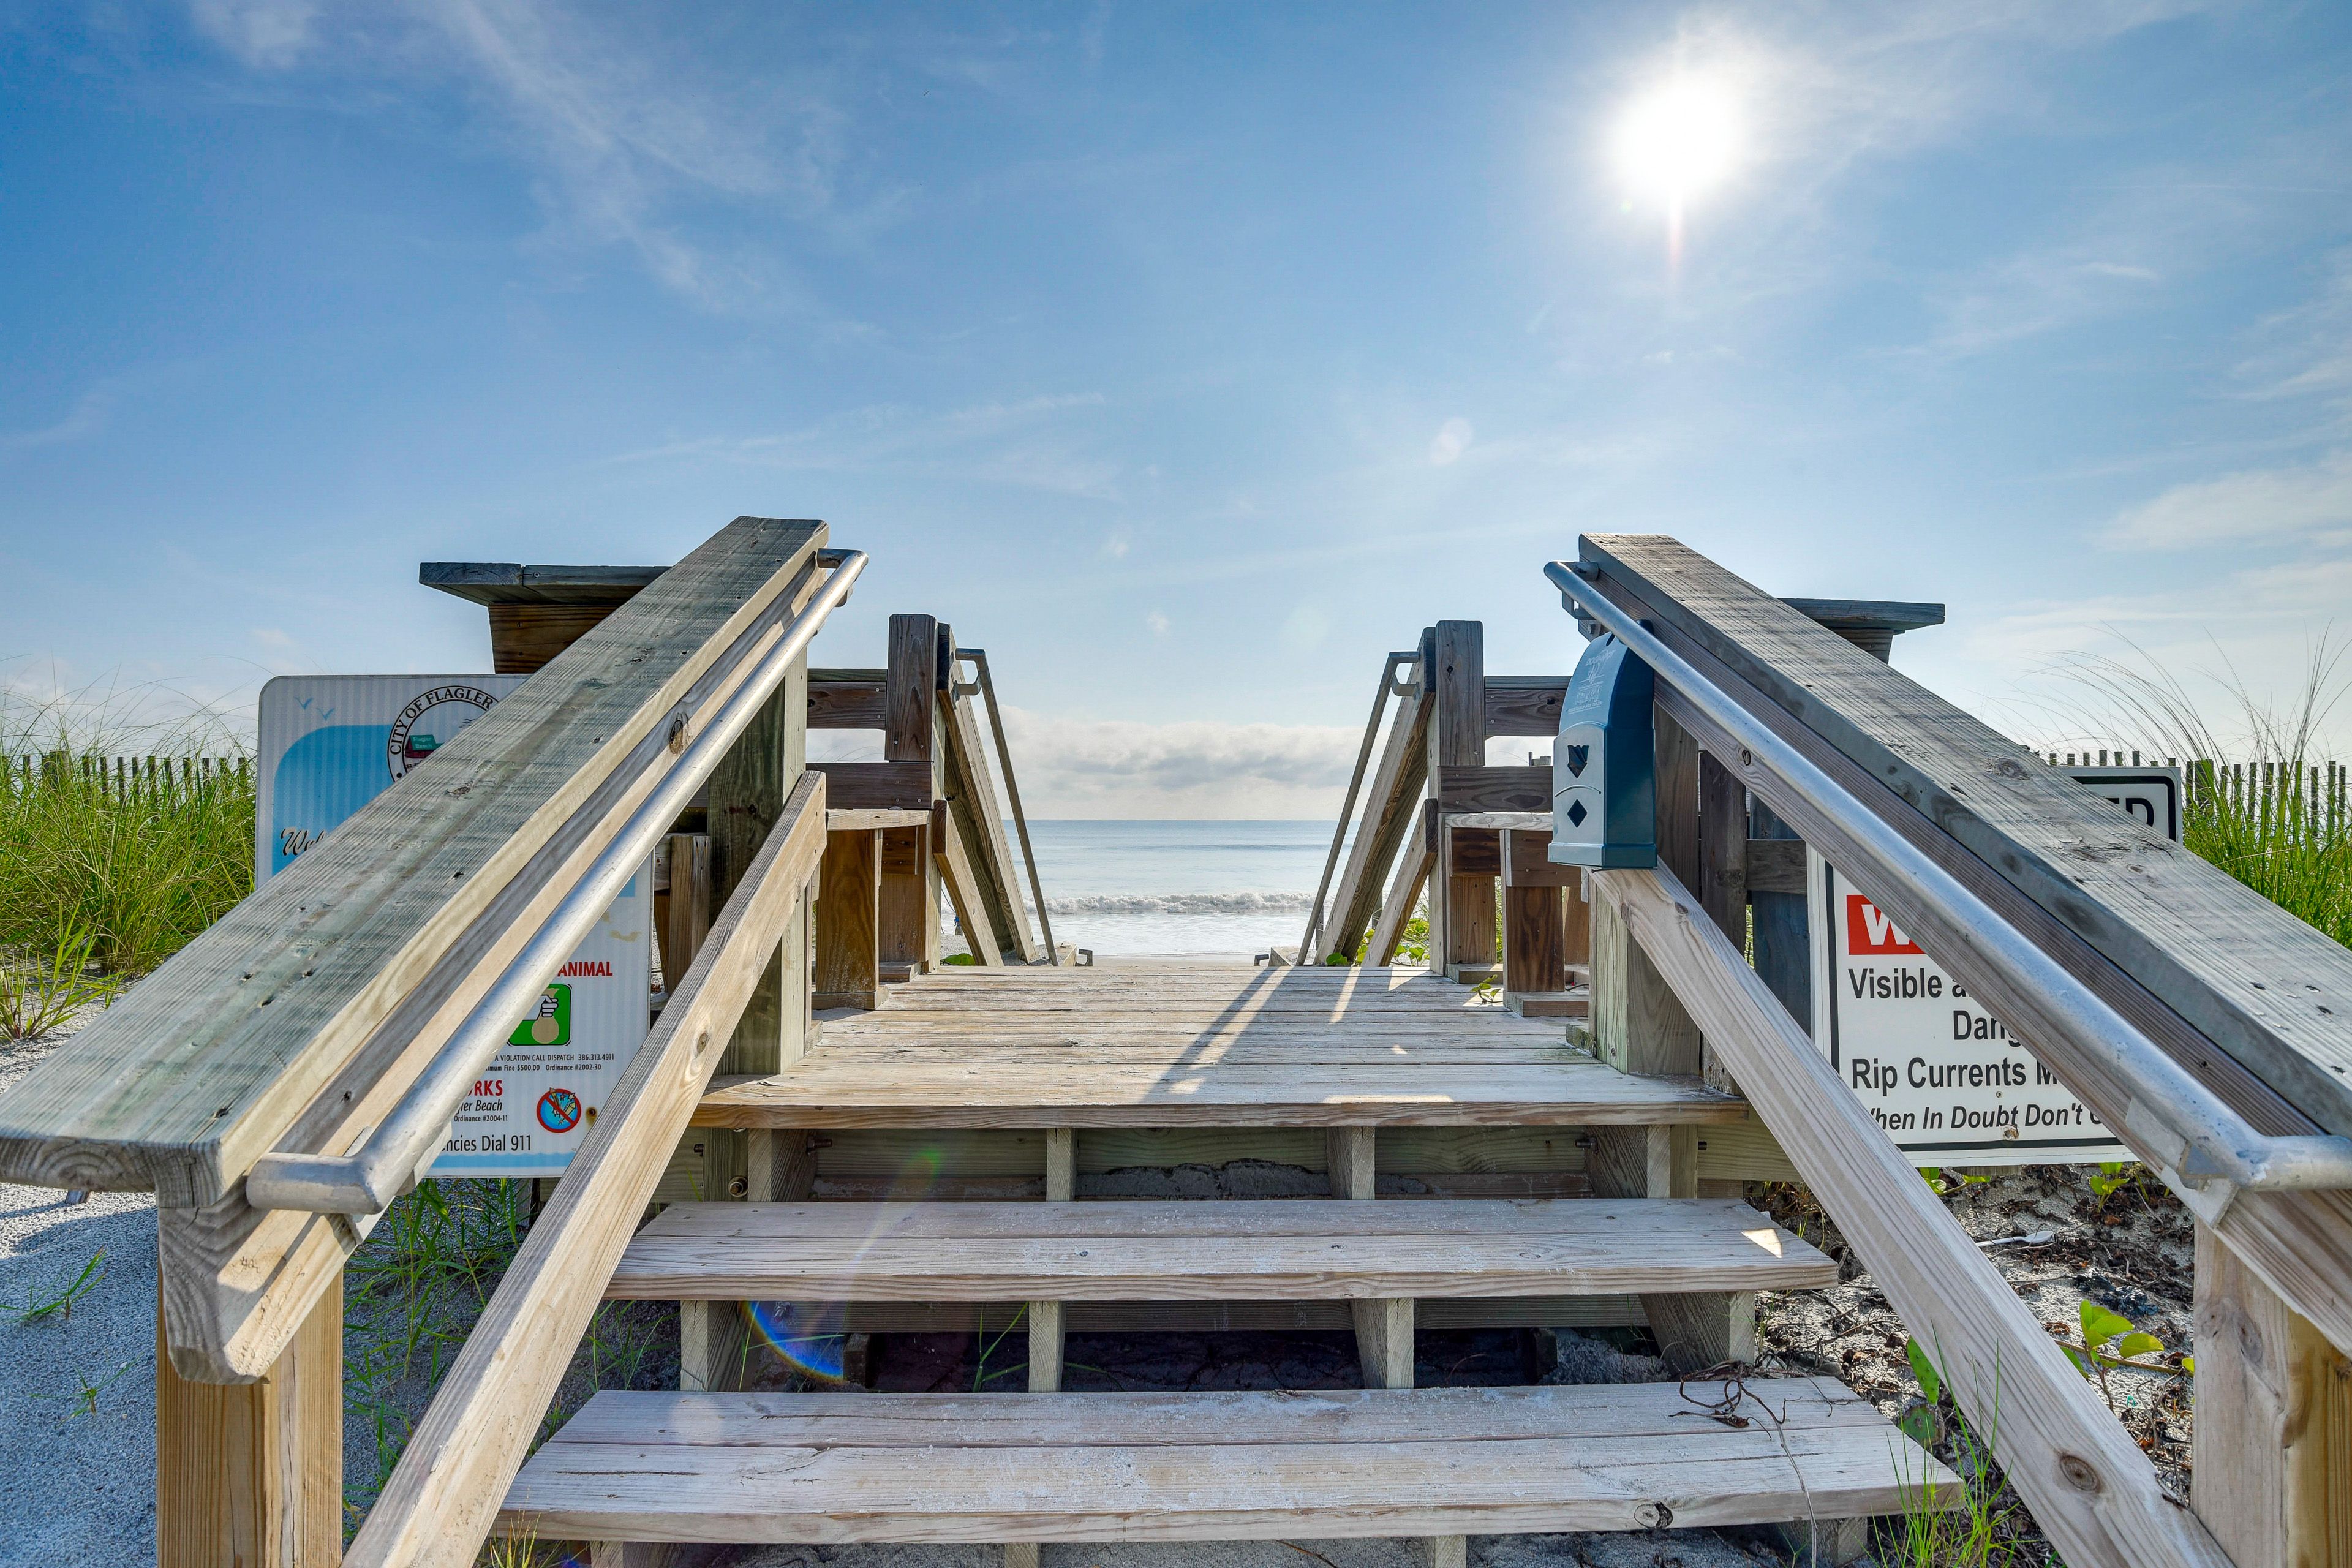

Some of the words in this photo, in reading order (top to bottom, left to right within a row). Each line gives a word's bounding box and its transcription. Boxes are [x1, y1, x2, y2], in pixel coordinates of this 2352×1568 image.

[390, 720, 408, 755] CITY
[405, 700, 423, 718] OF
[425, 688, 494, 709] FLAGLER
[2105, 797, 2154, 827] D
[557, 961, 613, 977] ANIMAL
[1848, 968, 1942, 998] Visible
[468, 1080, 503, 1096] RKS
[1852, 1058, 1898, 1096] Rip
[1907, 1057, 2026, 1088] Currents
[475, 1099, 503, 1112] Beach
[1871, 1107, 1915, 1130] hen
[1923, 1107, 1943, 1129] In
[1951, 1105, 2019, 1128] Doubt
[2025, 1103, 2083, 1126] Don't
[442, 1134, 477, 1152] ncies
[482, 1134, 506, 1152] Dial
[511, 1135, 531, 1151] 911
